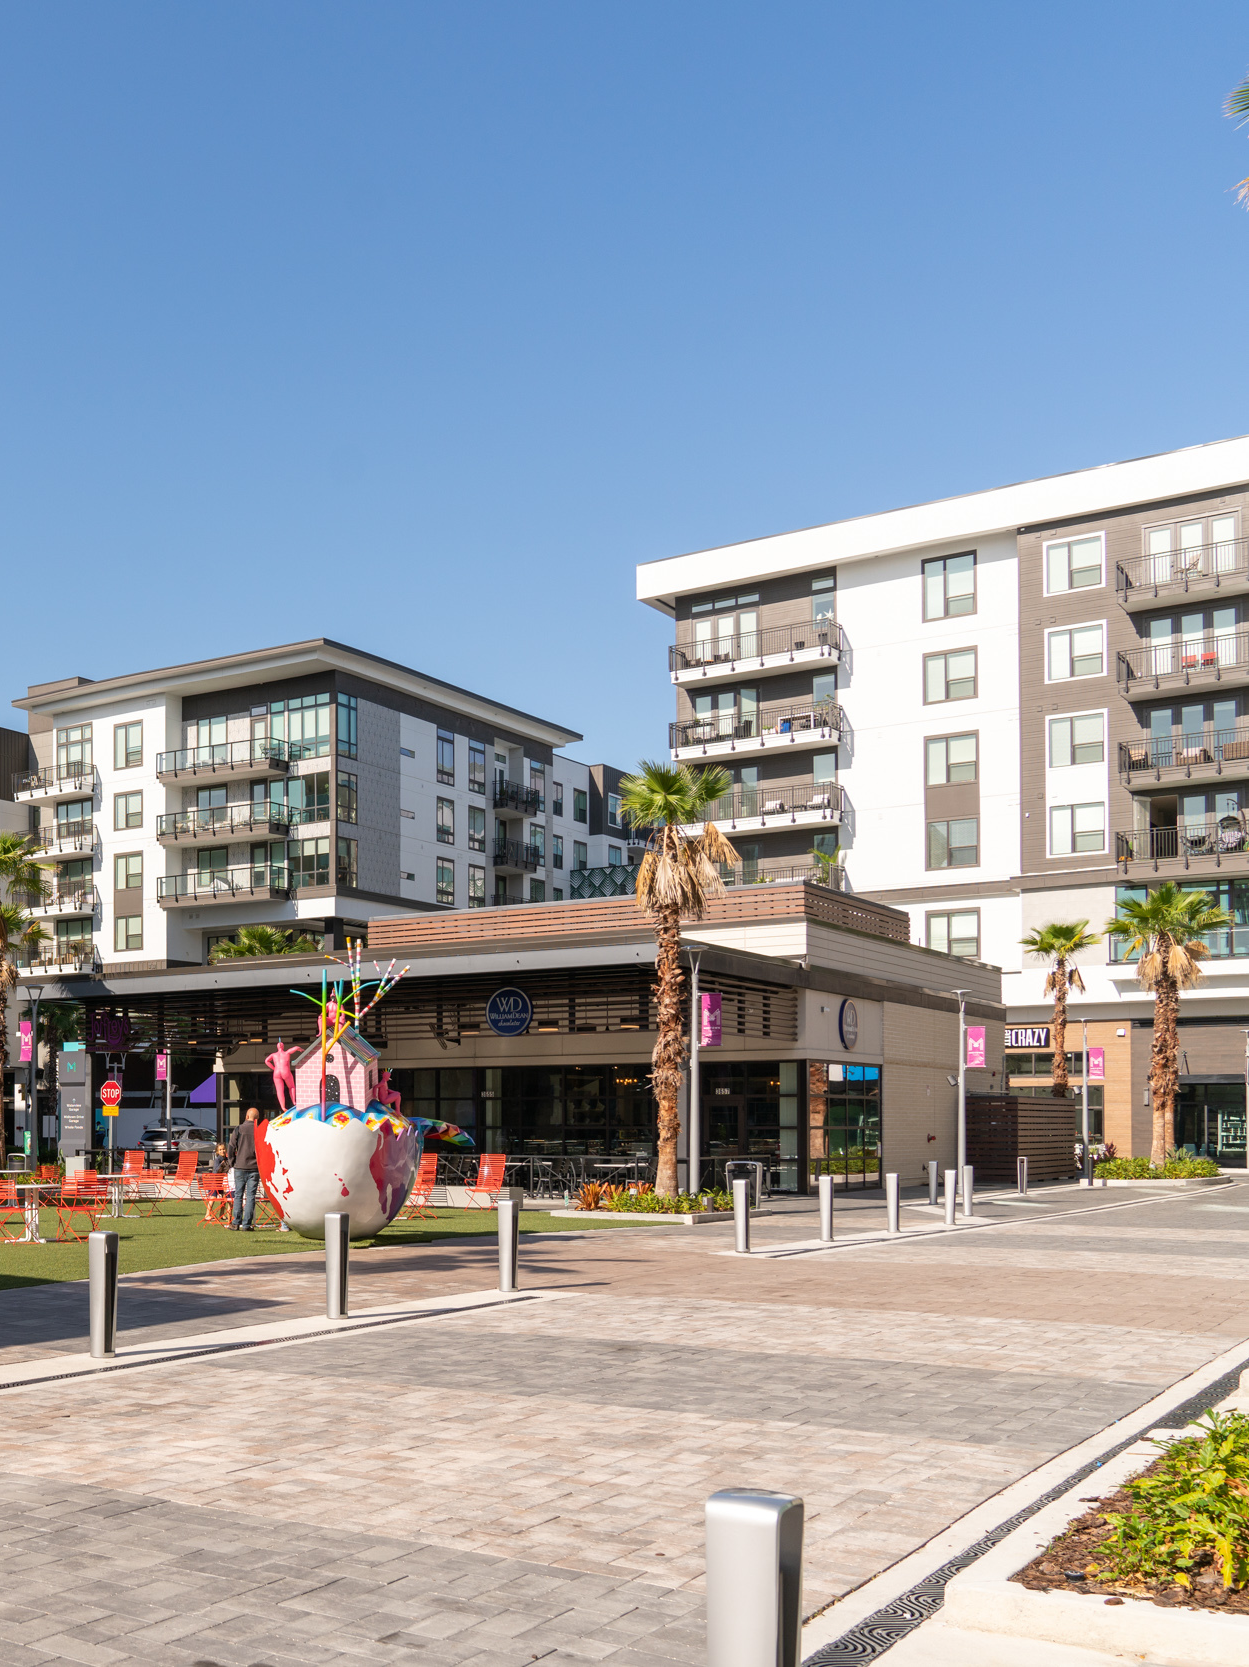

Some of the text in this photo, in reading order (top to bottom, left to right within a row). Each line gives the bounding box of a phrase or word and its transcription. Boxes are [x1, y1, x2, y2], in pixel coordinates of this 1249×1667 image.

[496, 996, 522, 1012] WD
[703, 1008, 721, 1026] M
[968, 1037, 984, 1051] M
[1011, 1028, 1048, 1047] CRAZY
[66, 1061, 77, 1072] M
[1090, 1056, 1103, 1067] M
[102, 1088, 120, 1099] STOP
